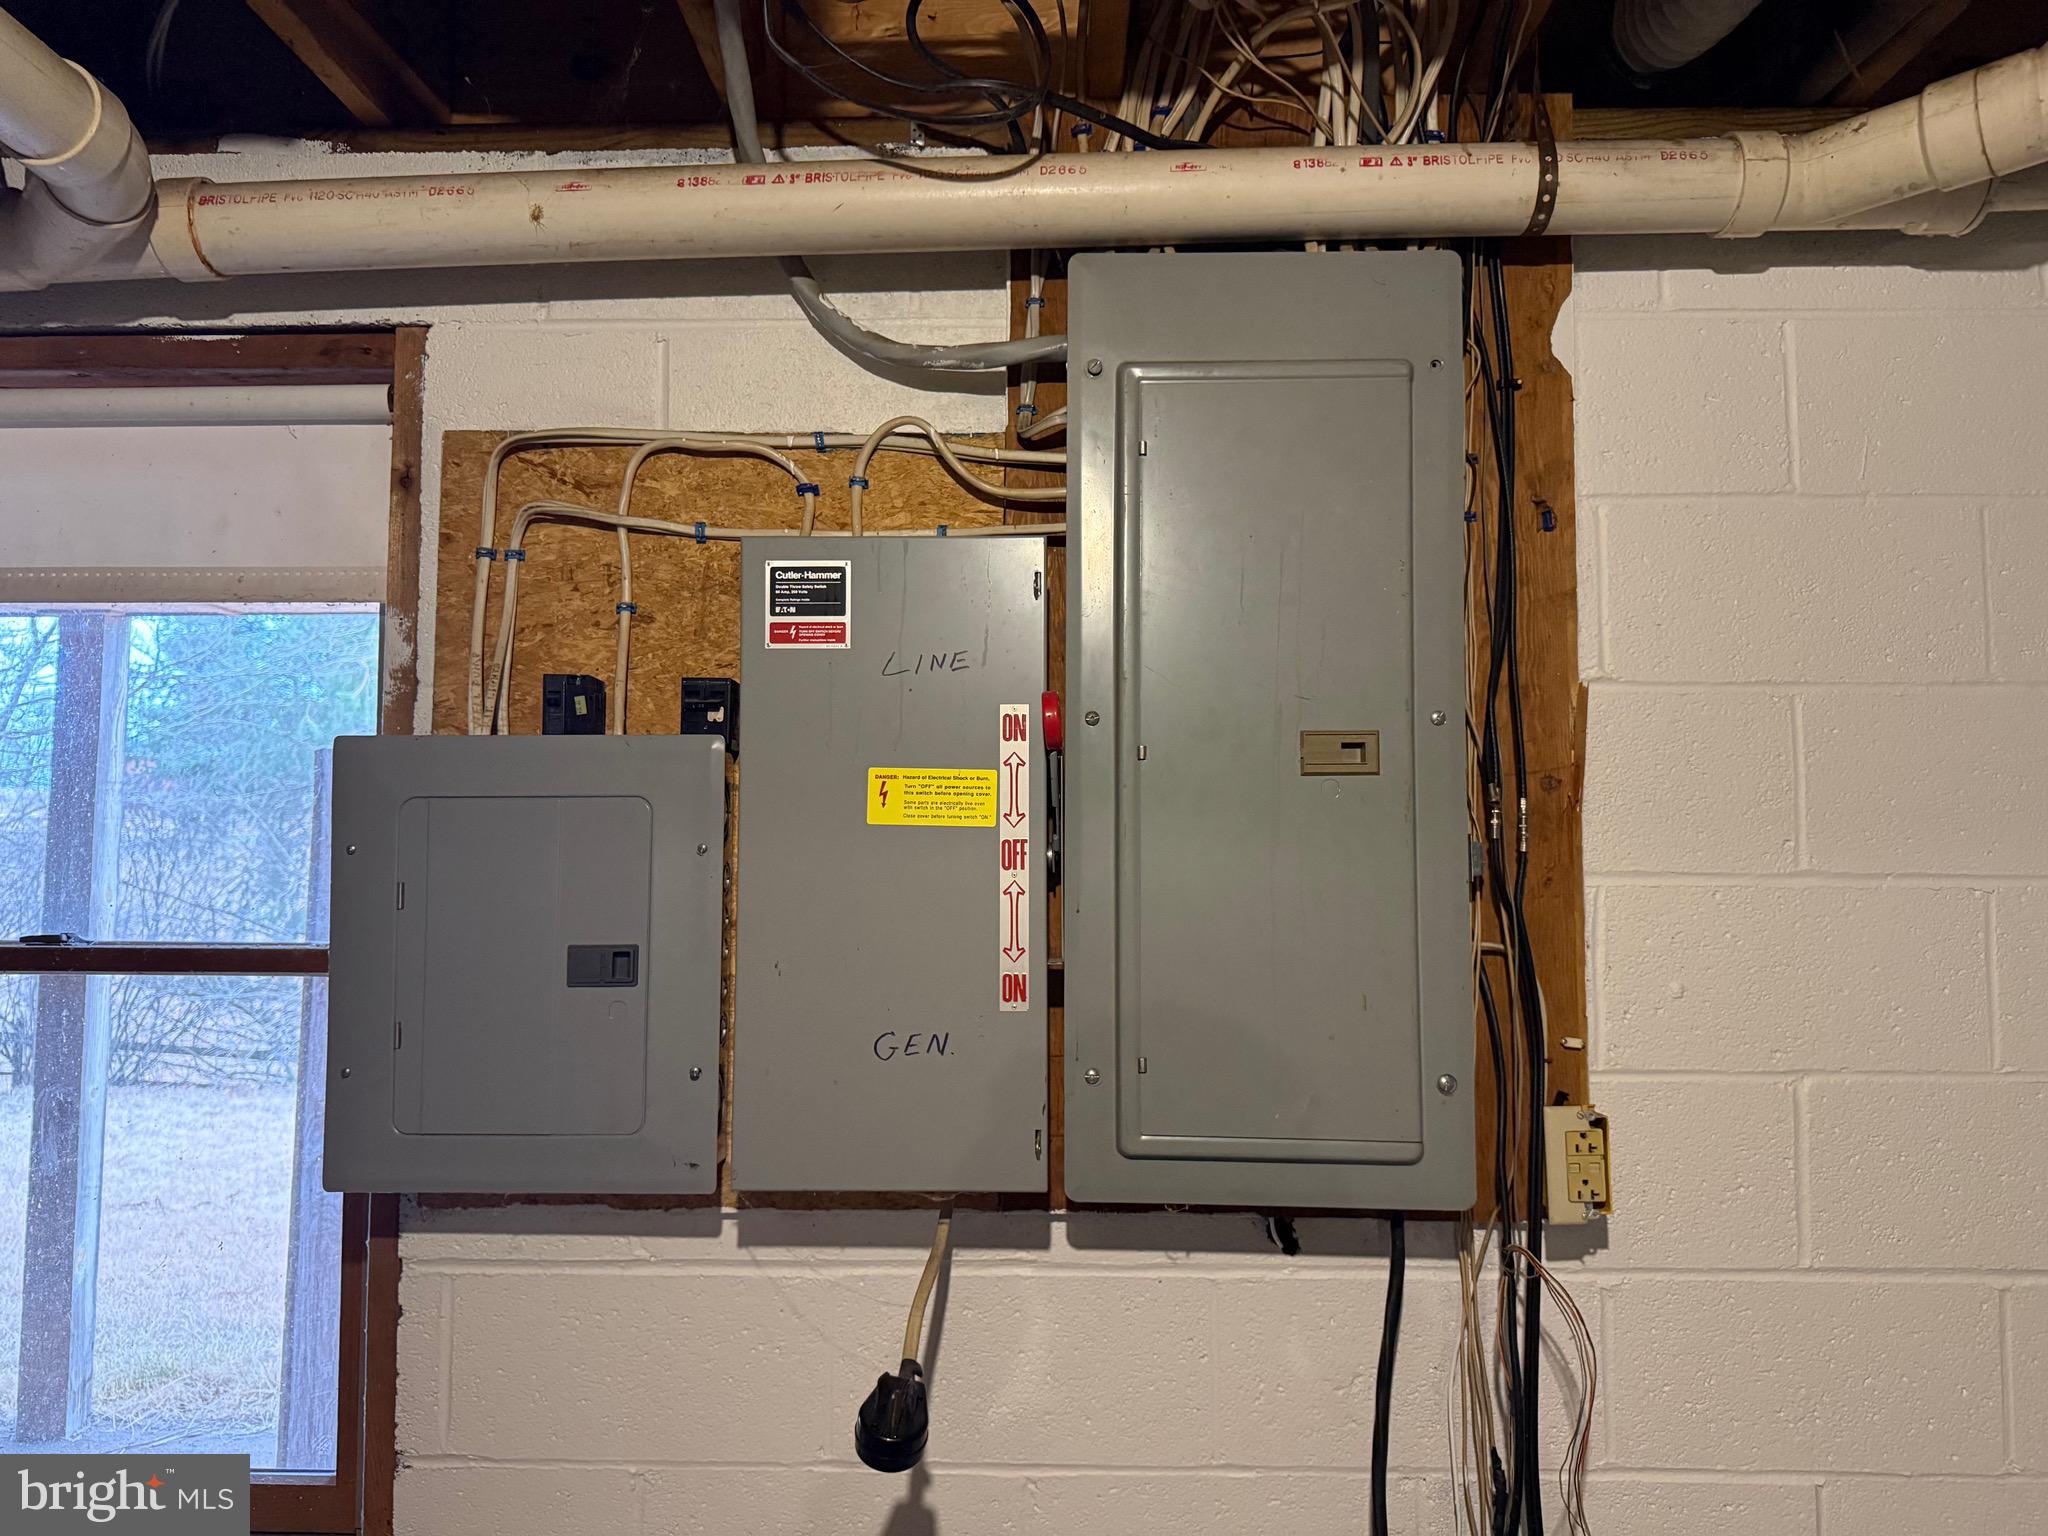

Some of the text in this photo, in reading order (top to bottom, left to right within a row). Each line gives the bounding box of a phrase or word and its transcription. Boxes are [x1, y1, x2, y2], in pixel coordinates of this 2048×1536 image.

[881, 650, 970, 678] LINE
[1002, 713, 1027, 742] ON
[1001, 839, 1028, 871] OFF
[1002, 973, 1027, 1002] ON
[873, 1030, 955, 1061] GEN.
